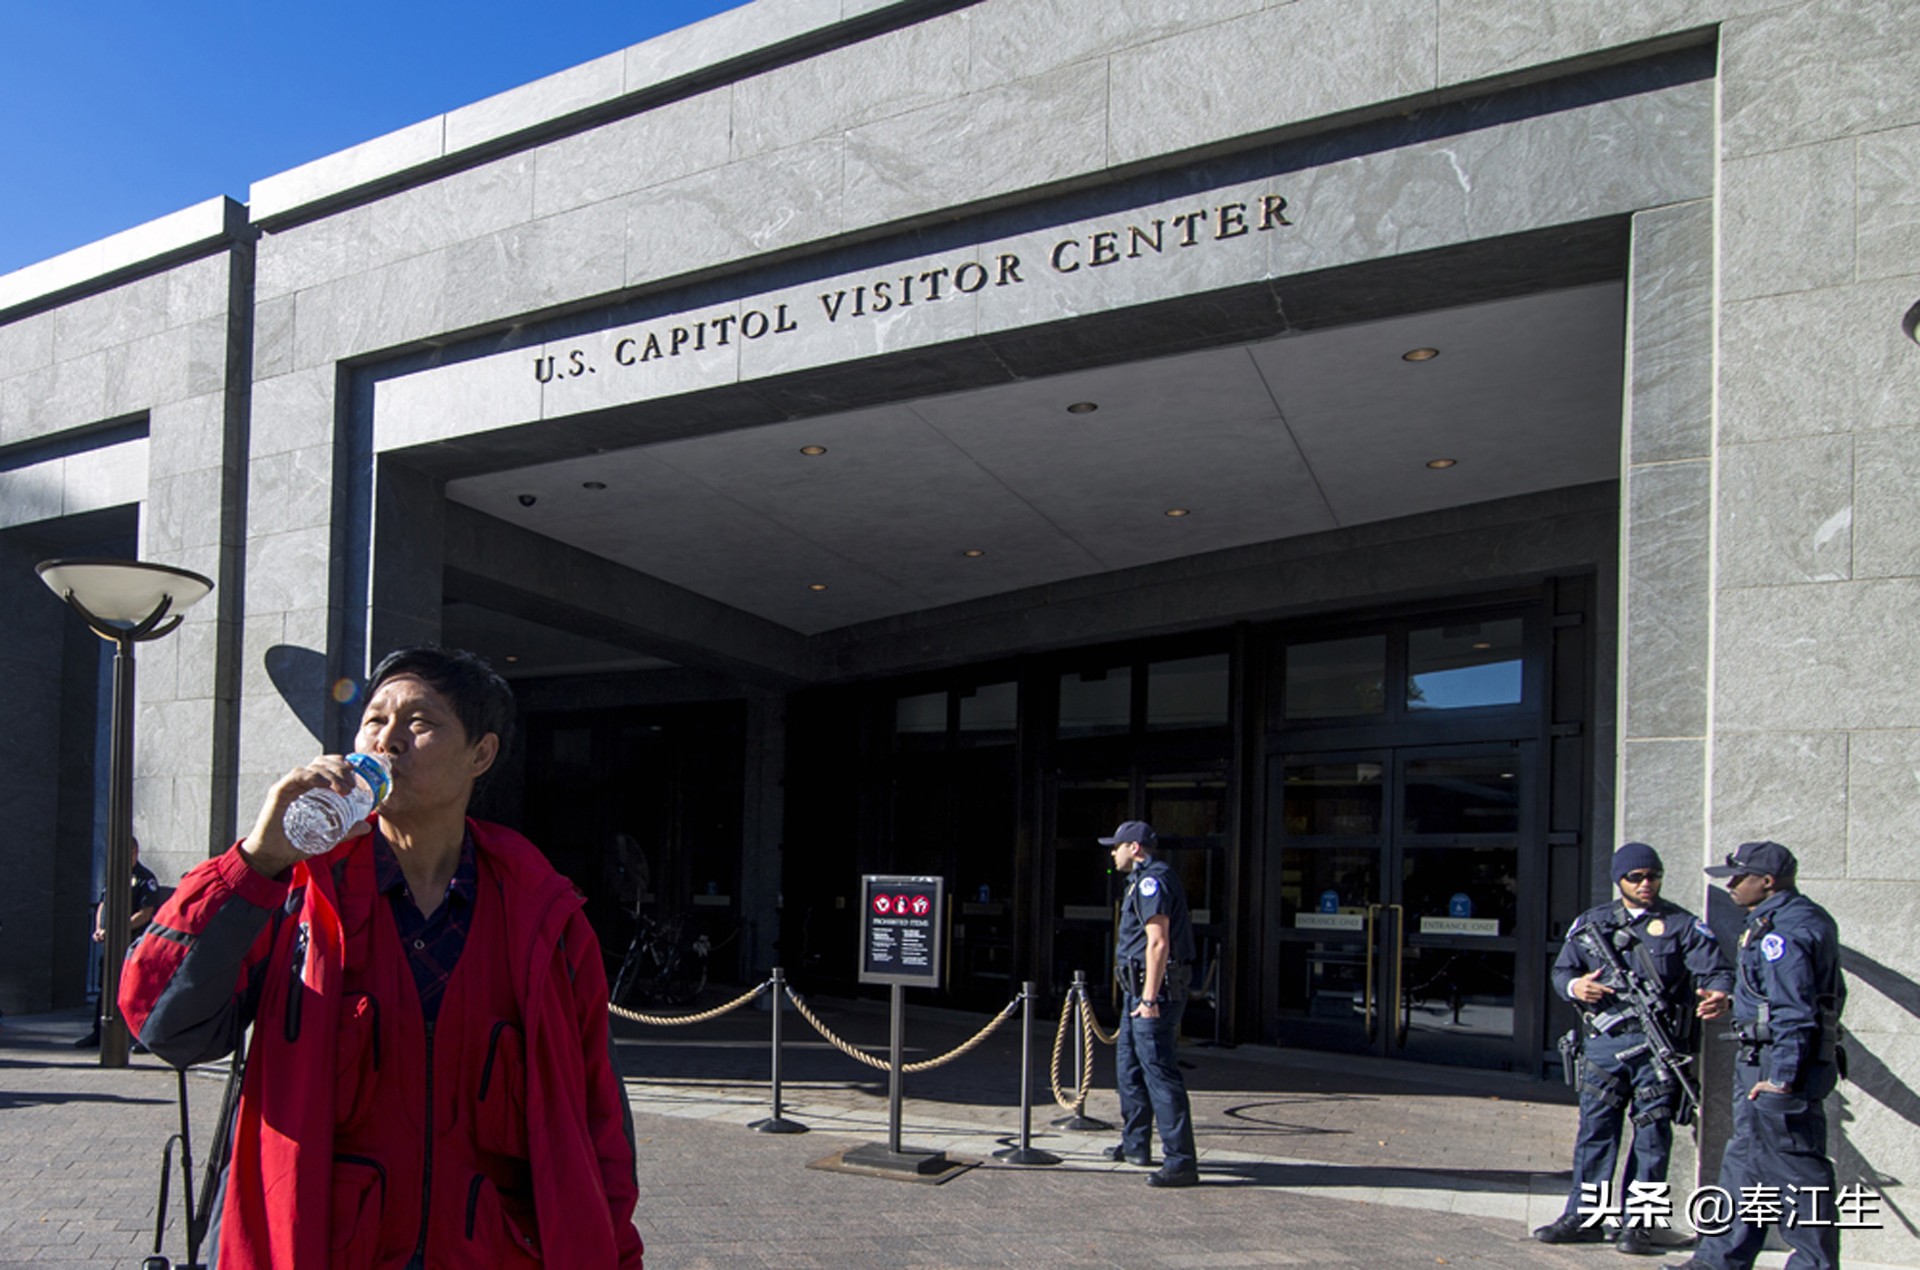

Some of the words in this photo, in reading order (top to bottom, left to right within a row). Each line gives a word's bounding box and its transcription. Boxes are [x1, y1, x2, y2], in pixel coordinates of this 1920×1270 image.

[534, 350, 596, 383] U.S.
[615, 304, 797, 366] CAPITOL
[818, 253, 1024, 322] VISITOR
[1050, 194, 1293, 273] CENTER
[1298, 915, 1336, 926] ENTRANCE
[1424, 920, 1467, 931] ENTRANCE
